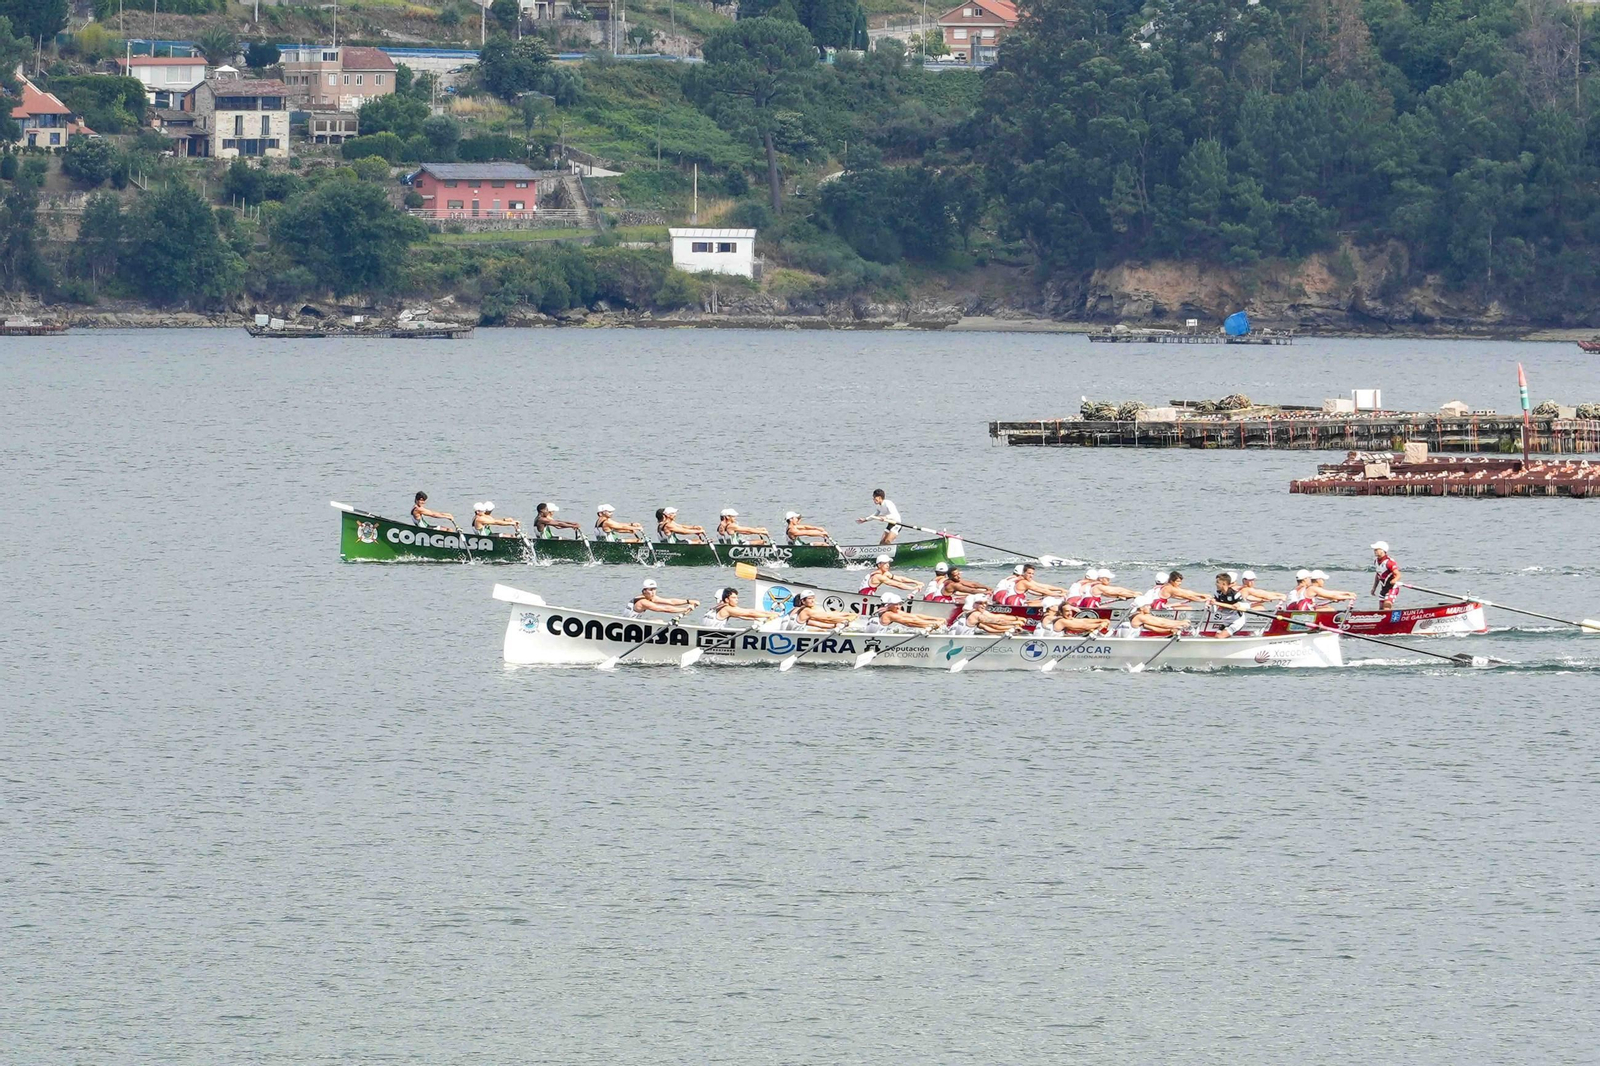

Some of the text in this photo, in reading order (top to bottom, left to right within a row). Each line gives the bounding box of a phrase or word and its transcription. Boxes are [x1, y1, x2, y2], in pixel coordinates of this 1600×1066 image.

[386, 528, 494, 551] CONGALSA
[728, 546, 793, 559] CAMPOS
[859, 546, 892, 554] Xacobeo
[1403, 608, 1424, 616] XUNTA
[1411, 612, 1436, 621] GALICIA
[546, 614, 690, 646] CONGALSA
[742, 633, 857, 655] RIBEIRA
[884, 650, 929, 659] DA CORUÑA
